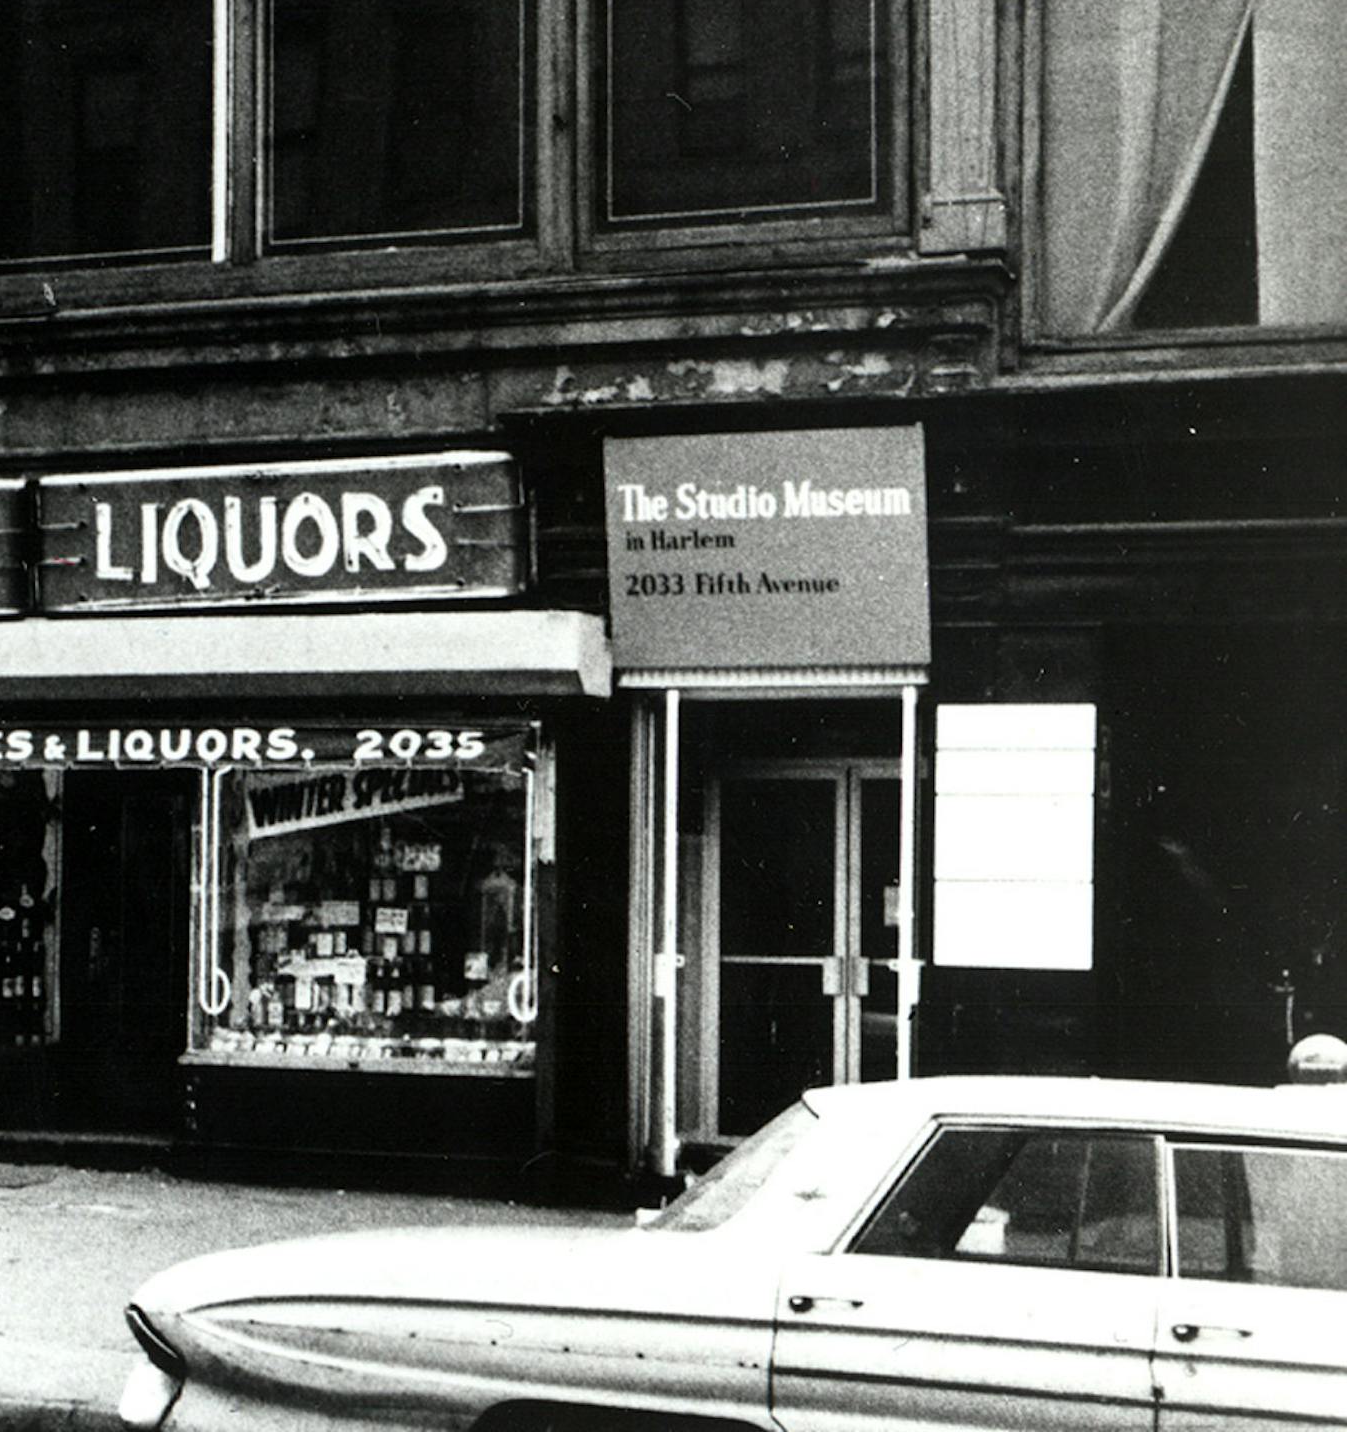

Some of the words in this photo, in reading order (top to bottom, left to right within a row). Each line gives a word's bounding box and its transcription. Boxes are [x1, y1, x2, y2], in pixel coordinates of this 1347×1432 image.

[617, 485, 669, 521] The
[675, 482, 777, 519] Studio
[783, 479, 913, 517] Museum
[93, 486, 449, 591] LIQUORS
[625, 531, 645, 551] in
[650, 528, 737, 550] Harlem
[625, 574, 685, 597] 2033
[694, 572, 752, 595] Fifth
[755, 573, 841, 594] Avenue
[43, 734, 67, 760] &
[76, 728, 316, 761] LIQUORS.
[354, 730, 487, 759] 2035
[248, 772, 348, 829] WINTER
